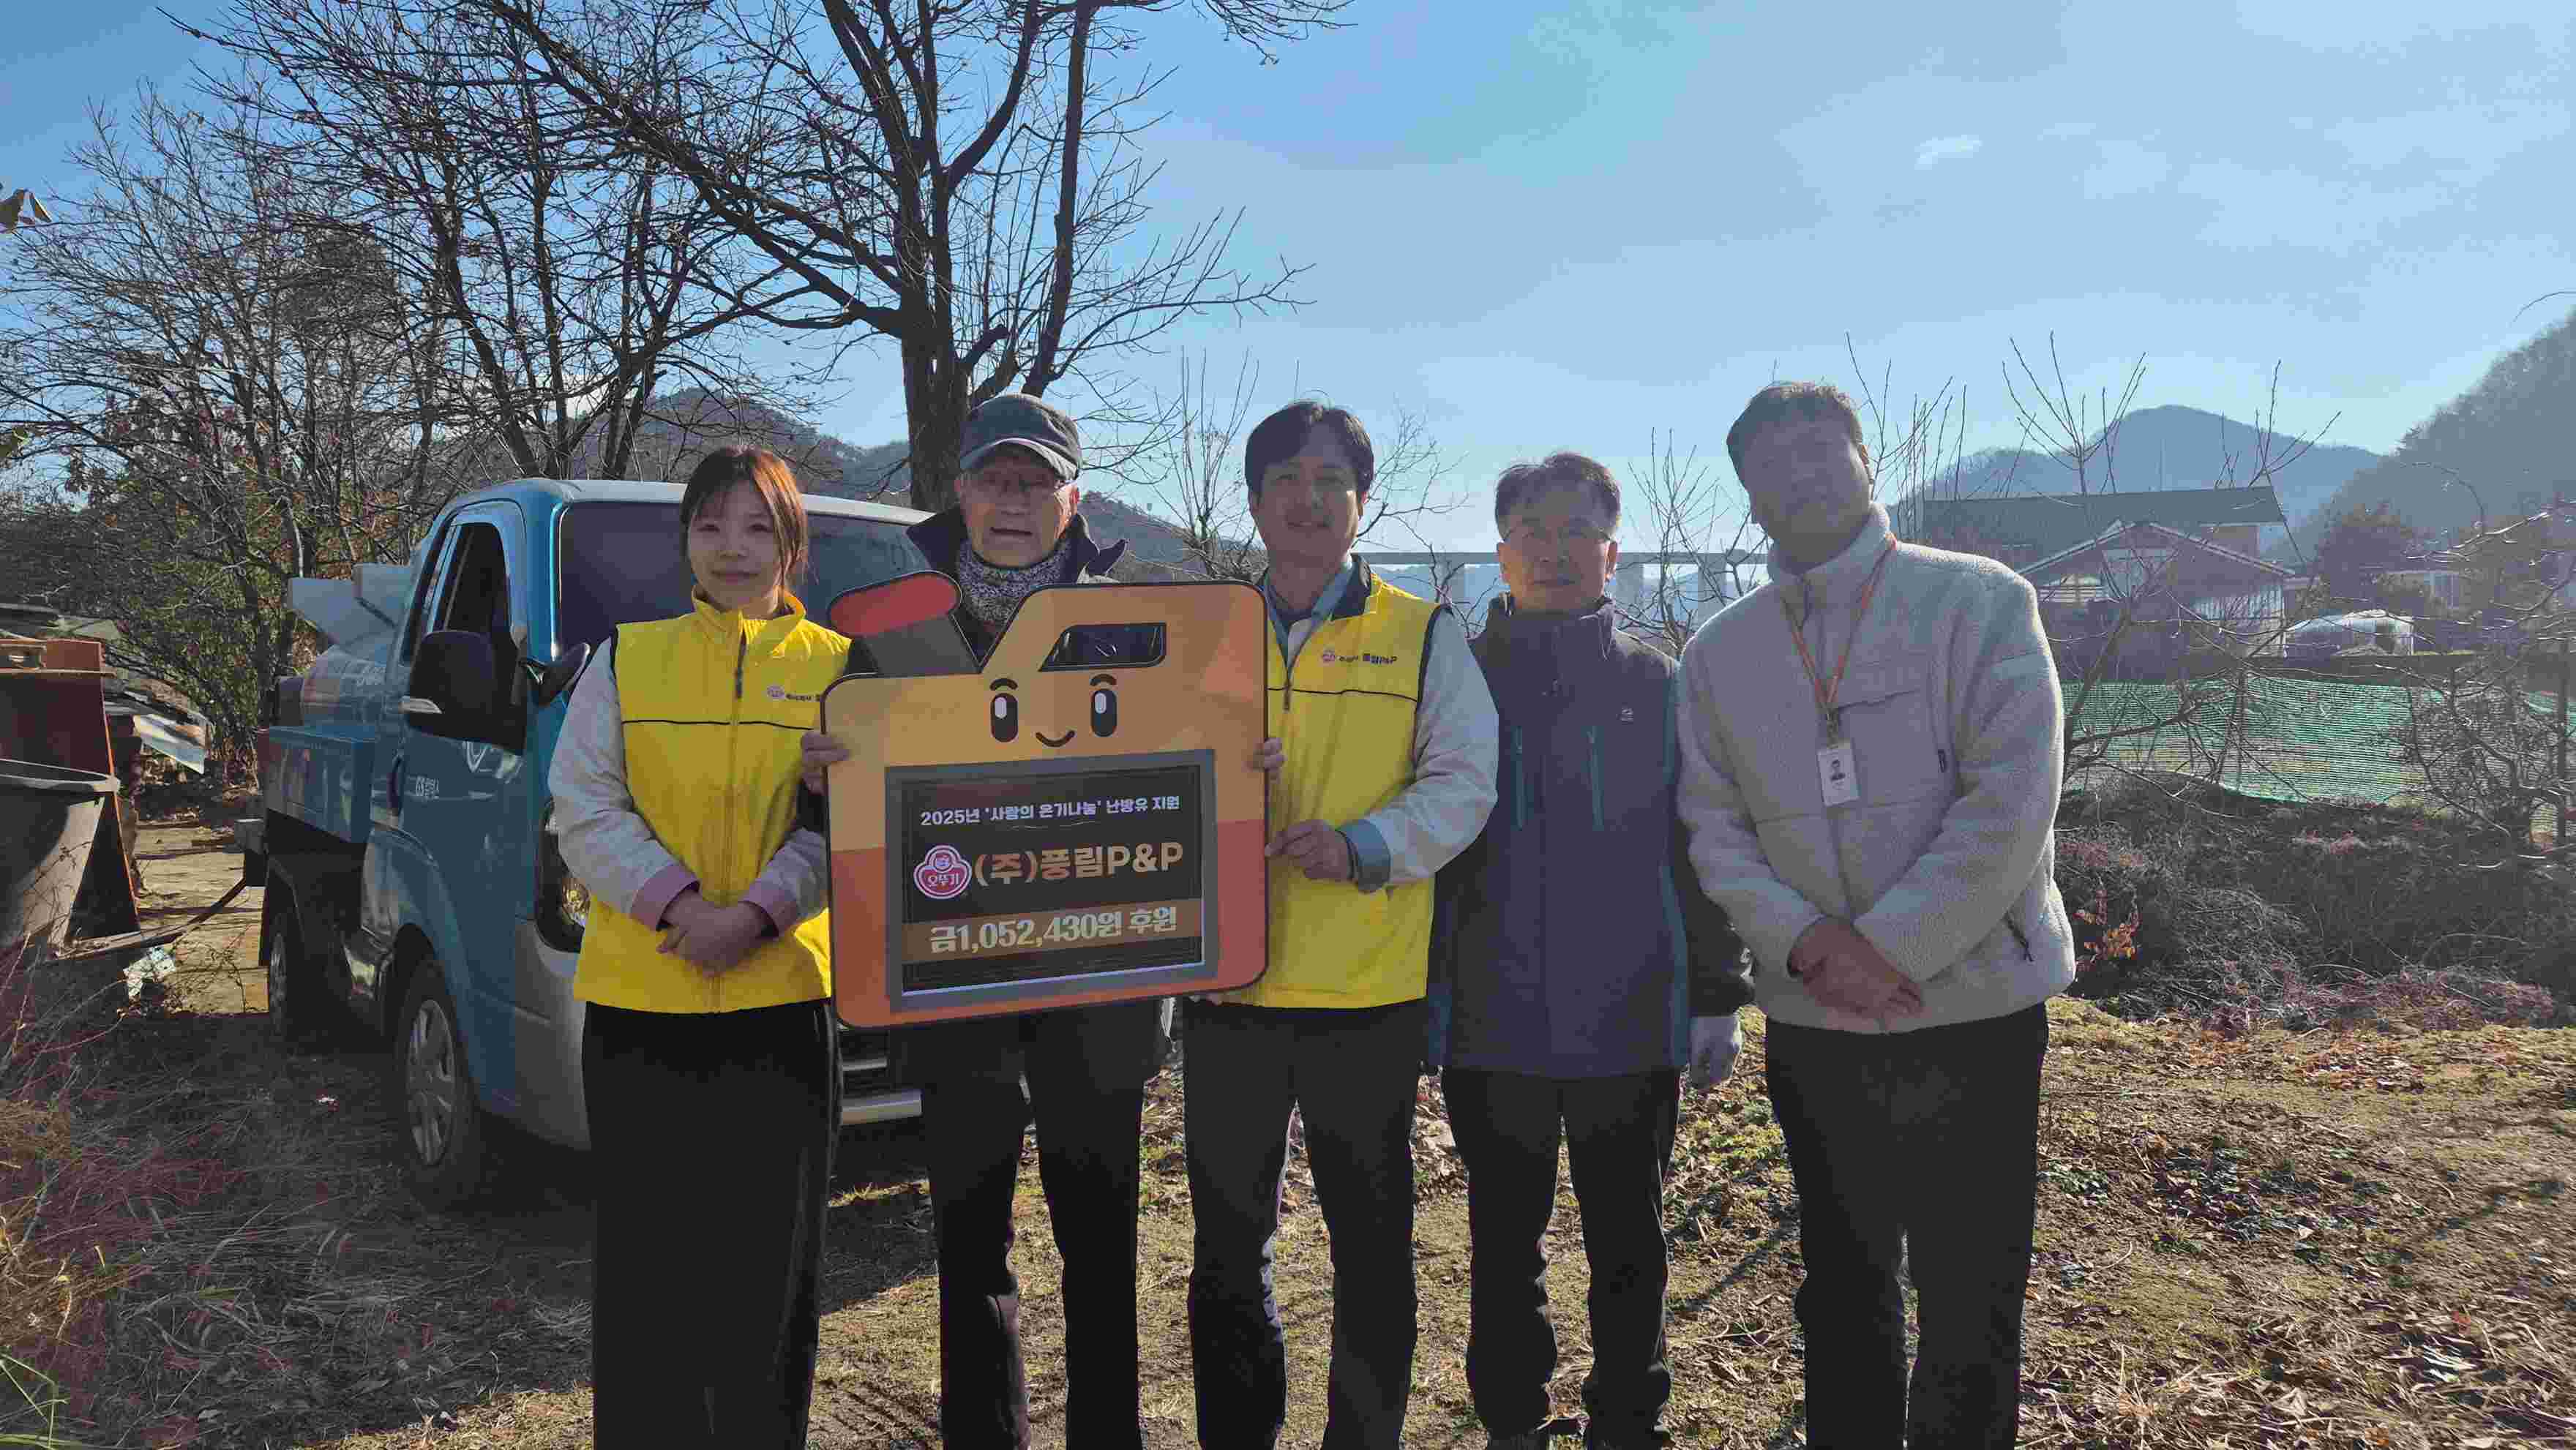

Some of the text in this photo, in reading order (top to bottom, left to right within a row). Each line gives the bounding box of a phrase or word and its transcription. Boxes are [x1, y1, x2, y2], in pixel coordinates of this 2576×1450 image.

[920, 808, 981, 826] 2025년
[1106, 797, 1148, 814] 난방유
[1151, 795, 1180, 811] 지원
[929, 906, 1177, 954] 금1,052,430원 후원
